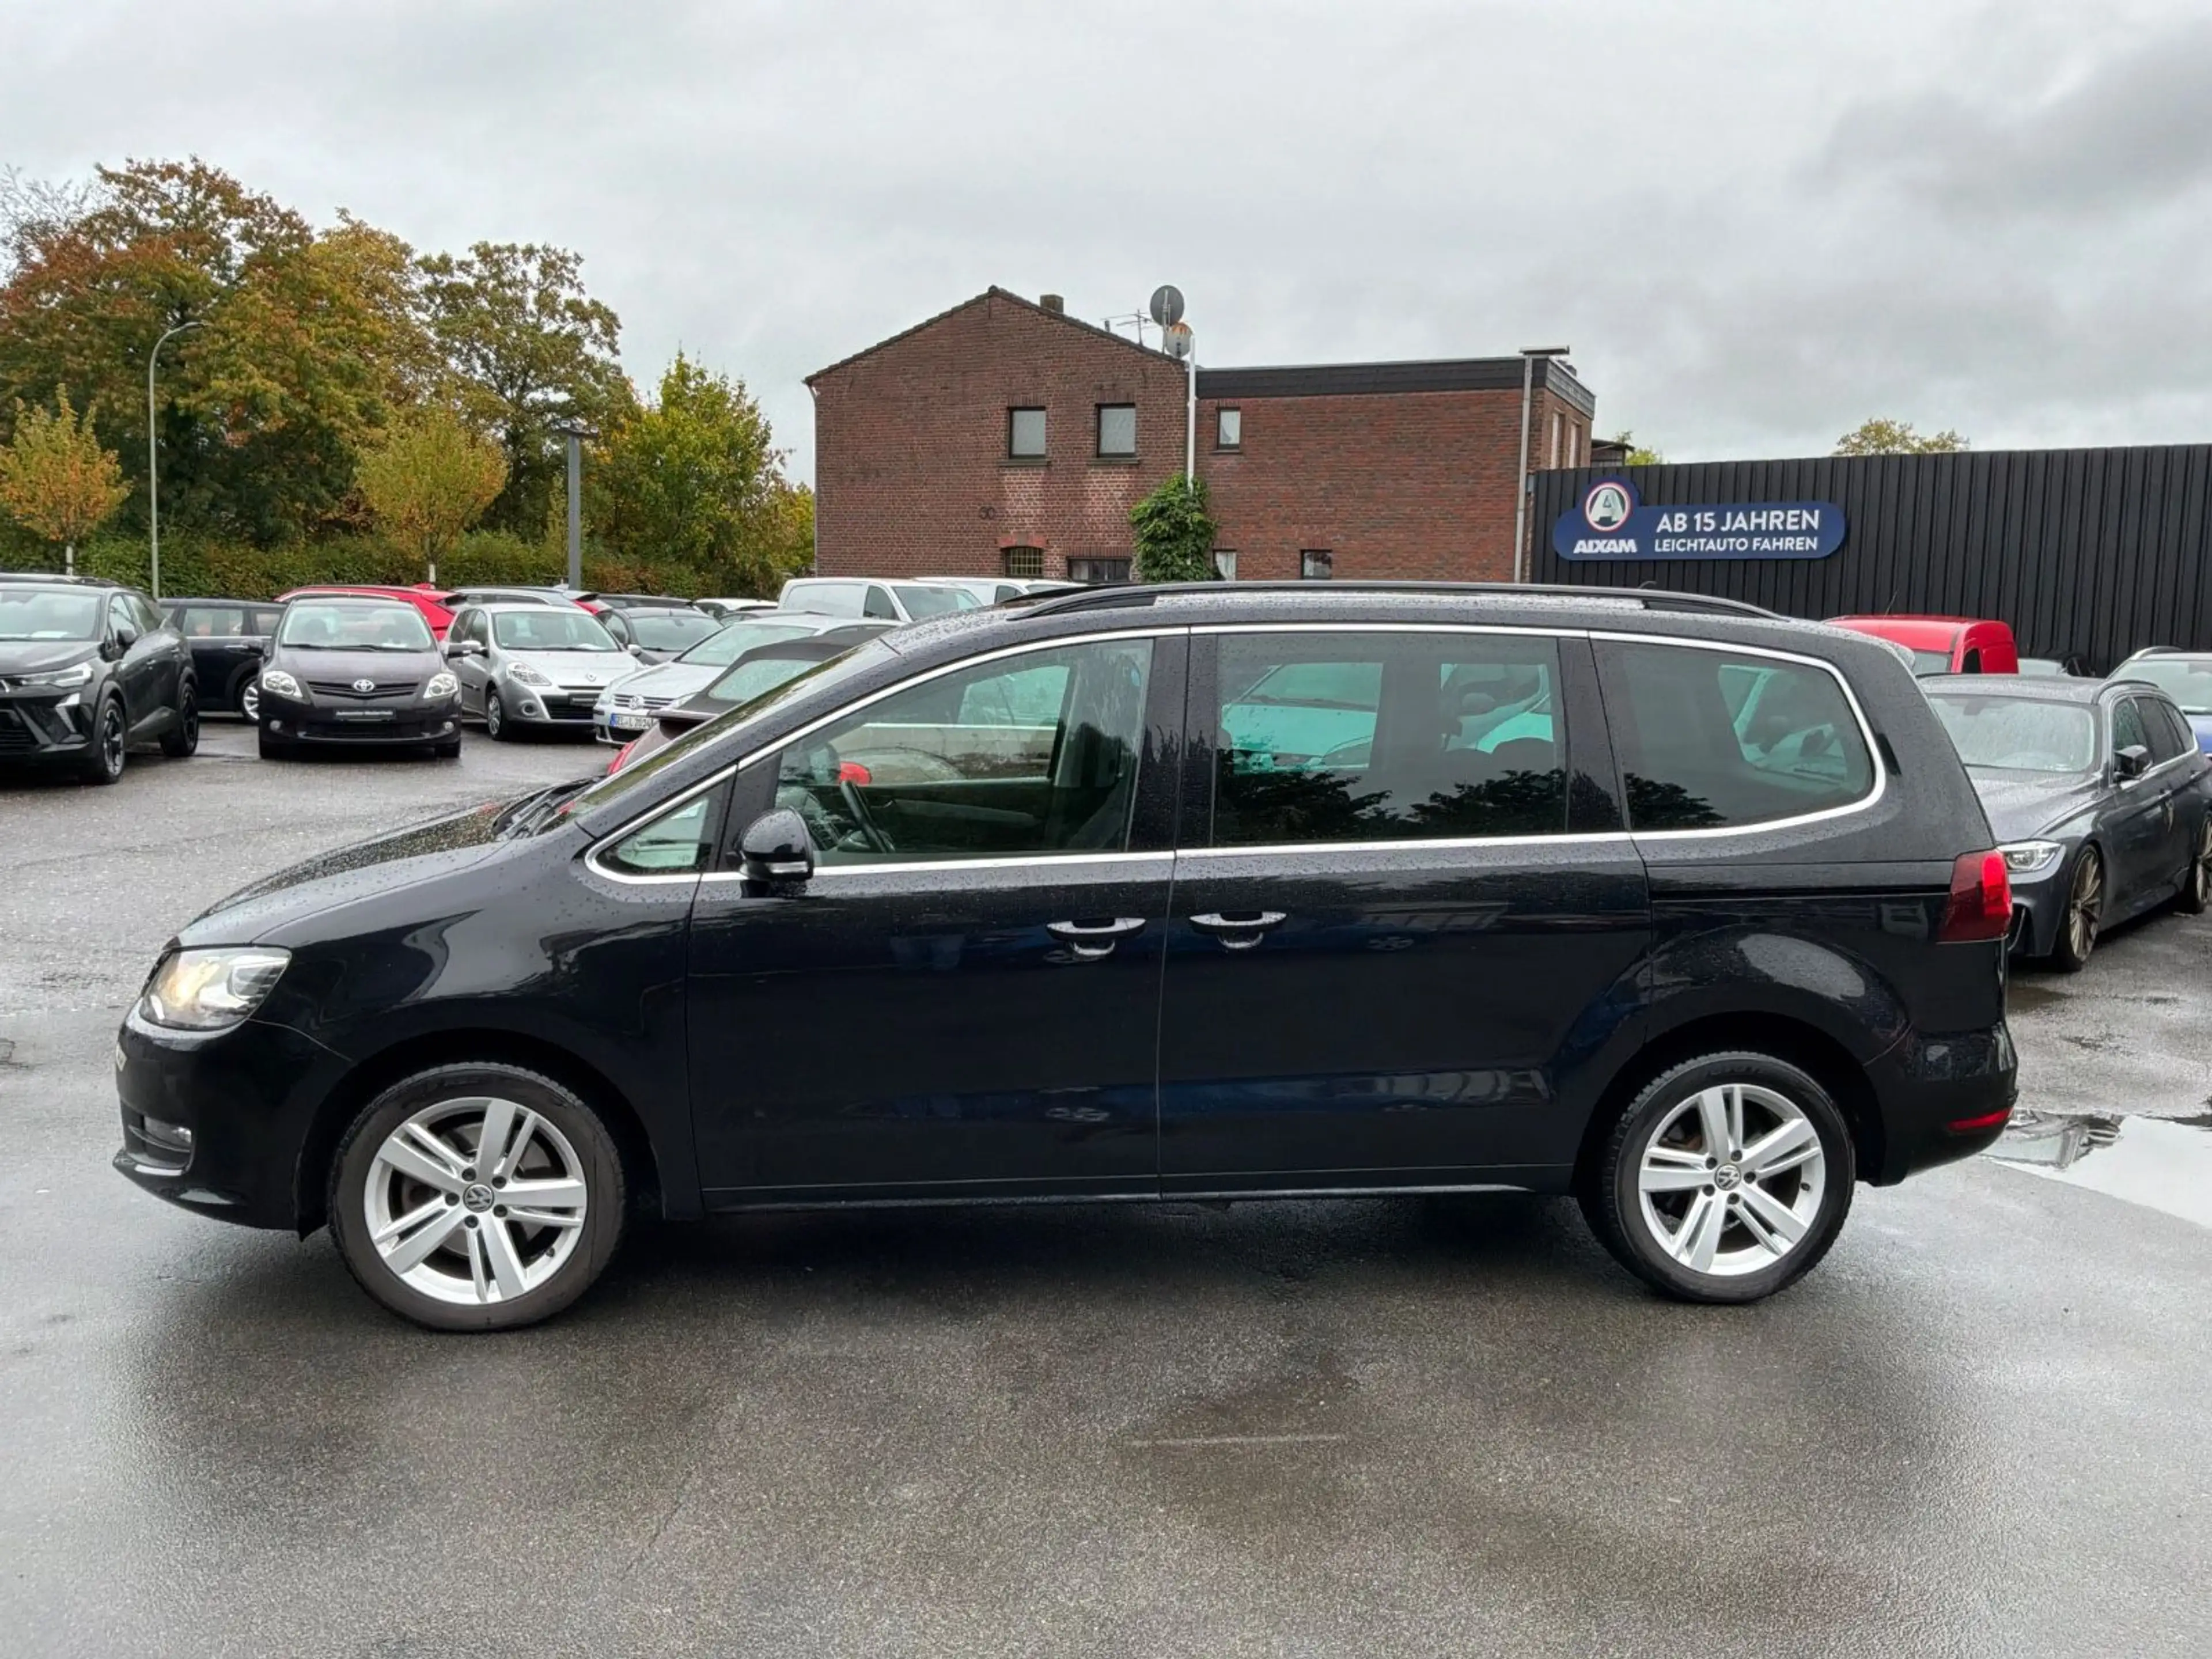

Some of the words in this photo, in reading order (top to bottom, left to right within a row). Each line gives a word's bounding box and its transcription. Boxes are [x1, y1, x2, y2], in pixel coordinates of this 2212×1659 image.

[1656, 512, 1688, 533] AB
[1694, 512, 1716, 532] 15
[1720, 509, 1820, 532] JAHREN
[1573, 539, 1638, 554] AIXAM
[1654, 537, 1748, 552] LEICHTAUTO
[1752, 536, 1818, 551] FAHREN
